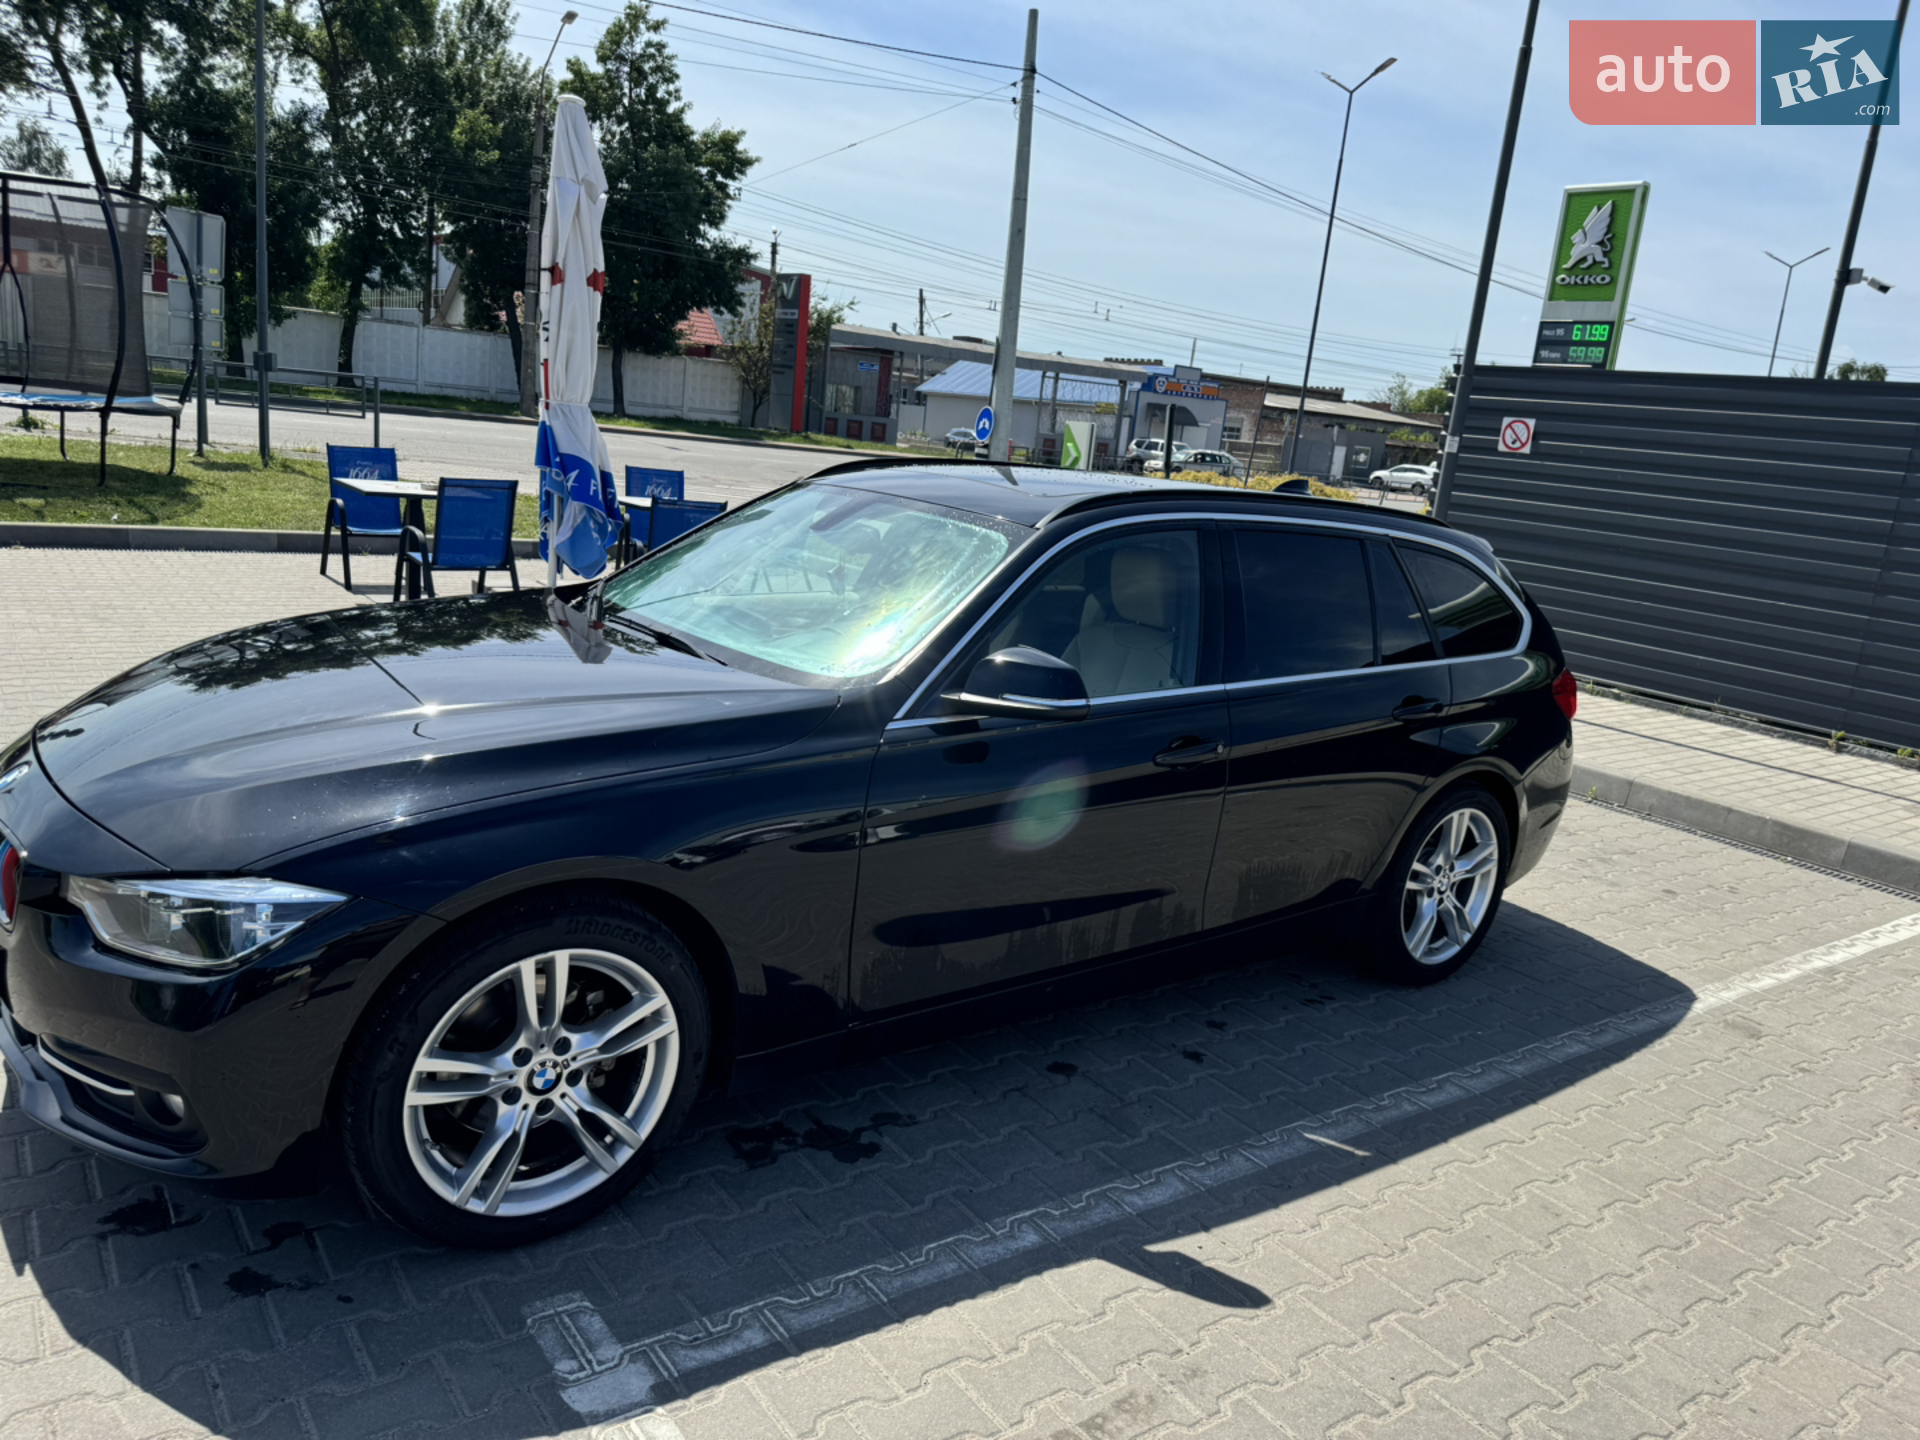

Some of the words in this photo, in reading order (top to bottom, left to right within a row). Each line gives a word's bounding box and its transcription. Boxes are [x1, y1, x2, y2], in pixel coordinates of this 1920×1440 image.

[1555, 274, 1611, 285] OKKO
[1571, 324, 1609, 341] 61.99
[1567, 346, 1605, 363] 59.99
[348, 466, 380, 480] 1664
[644, 484, 673, 498] 1664
[564, 917, 673, 965] BRIDGESTONE
